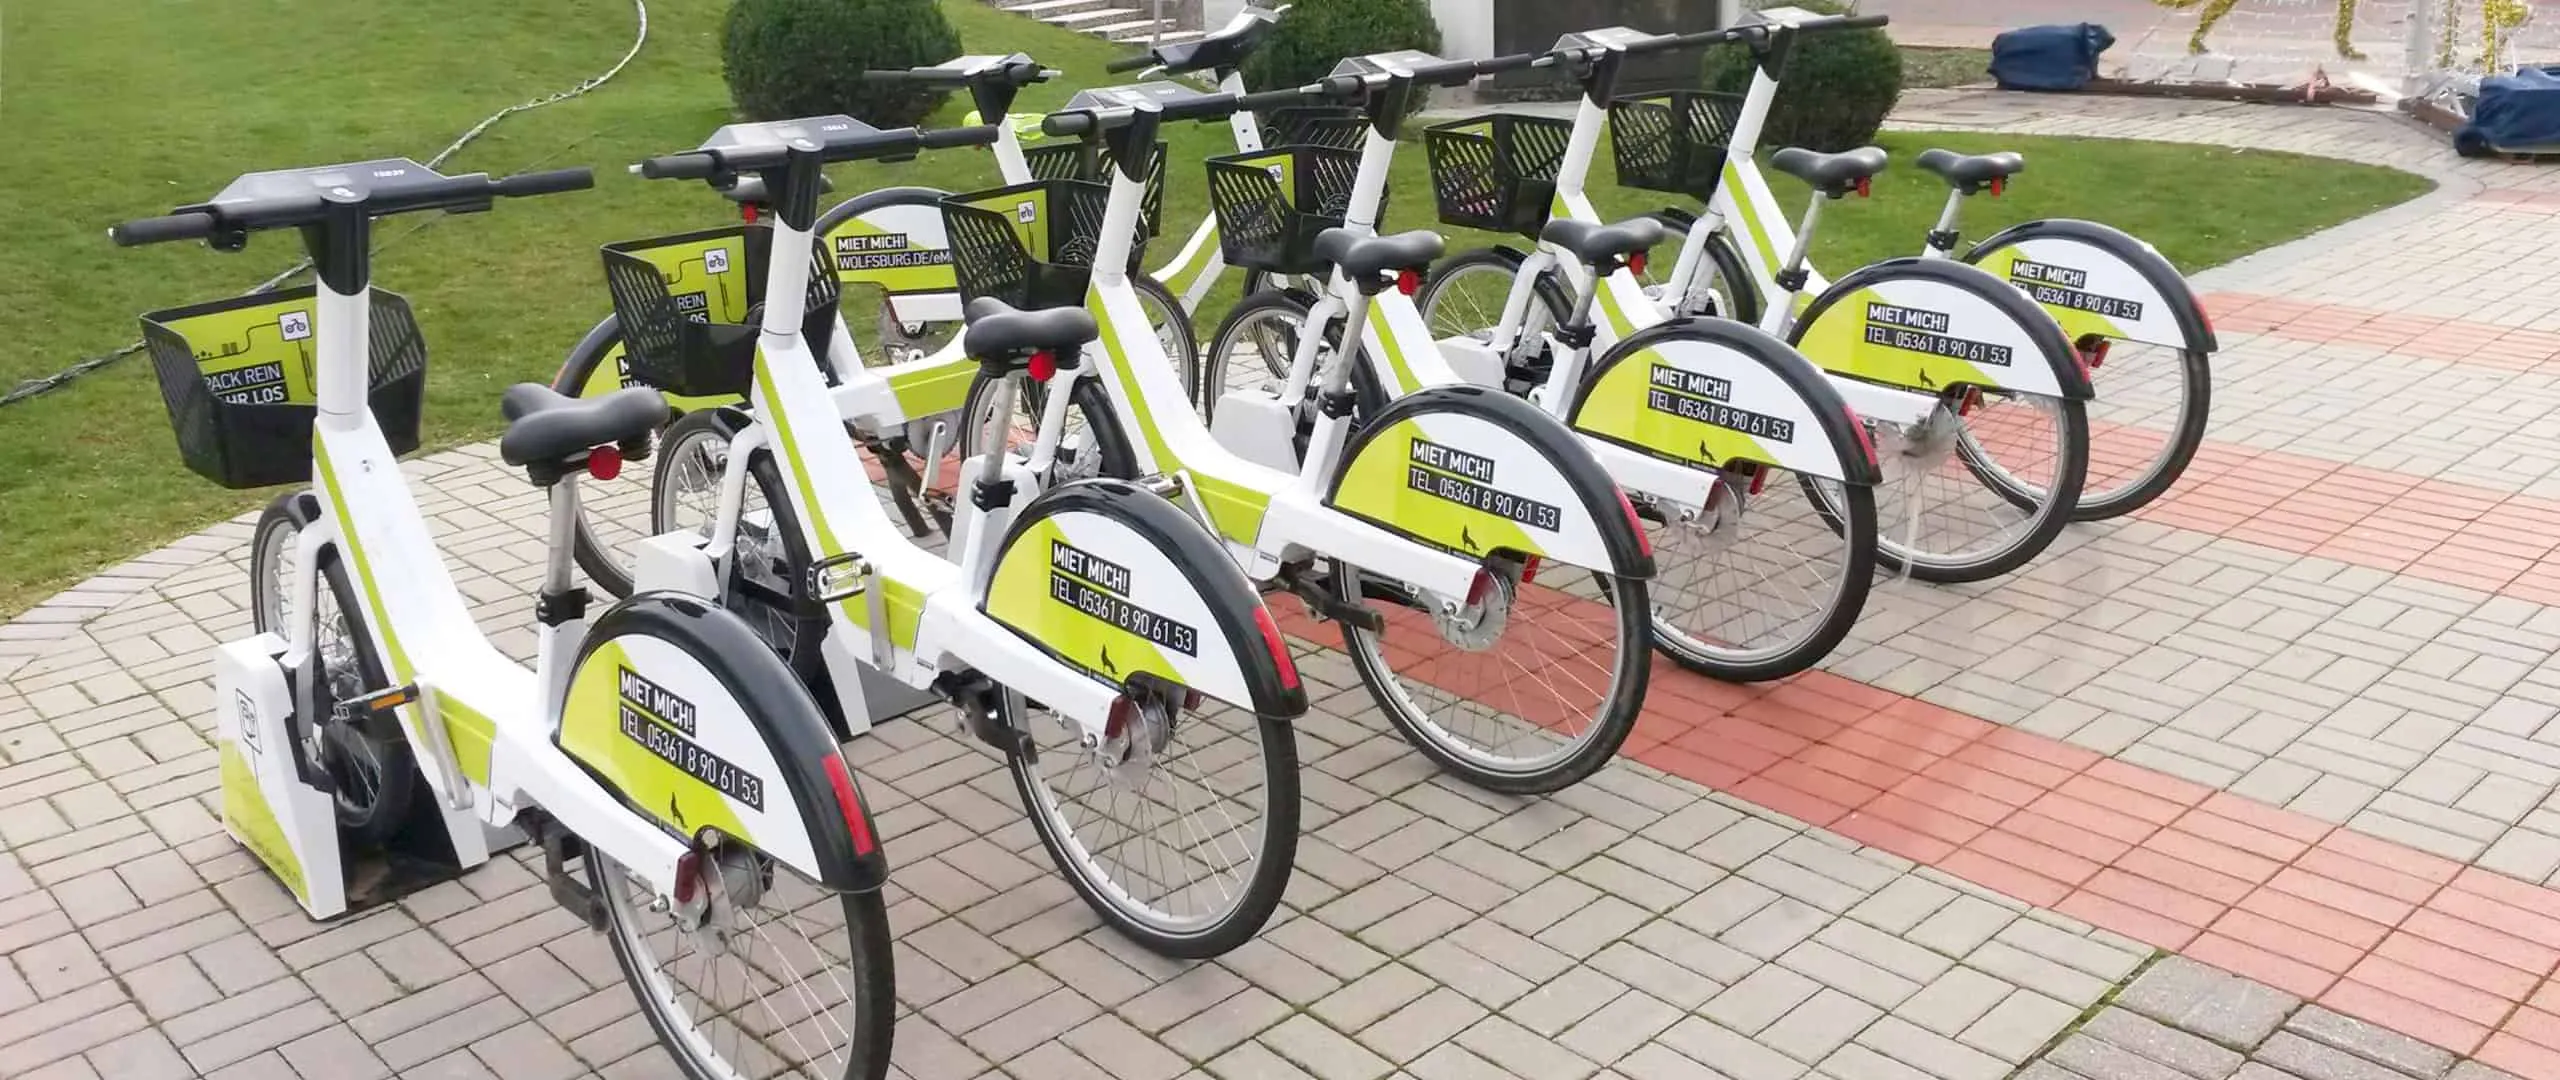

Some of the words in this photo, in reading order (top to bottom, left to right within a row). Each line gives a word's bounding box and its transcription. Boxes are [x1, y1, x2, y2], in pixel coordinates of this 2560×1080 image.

[838, 237, 867, 251] MIET
[871, 235, 905, 249] MICH!
[839, 250, 953, 269] WOLFSBURG.DE/eM
[2014, 261, 2045, 279] MIET
[2046, 267, 2084, 288] MICH!
[677, 293, 705, 309] REIN
[1869, 304, 1902, 324] MIET
[1905, 311, 1946, 331] MICH!
[2036, 286, 2071, 306] 05361
[2074, 294, 2082, 308] 8
[2086, 296, 2101, 312] 90
[2103, 298, 2118, 315] 61
[2121, 303, 2138, 318] 53
[1867, 326, 1892, 344] TEL.
[1895, 331, 1933, 352] 05361
[1938, 338, 1946, 353] 8
[1950, 340, 1967, 357] 90
[1969, 344, 1985, 360] 61
[1990, 347, 2008, 363] 53
[244, 363, 281, 384] REIN
[1652, 365, 1685, 388] MIET
[1688, 374, 1728, 399] MICH!
[252, 385, 284, 404] LOS
[1650, 389, 1675, 412] TEL.
[1678, 398, 1714, 422] 05361
[1720, 408, 1729, 425] 8
[1732, 411, 1748, 430] 90
[1751, 416, 1766, 435] 61
[1772, 420, 1790, 440] 53
[1412, 440, 1446, 465] MIET
[1450, 453, 1491, 480] MICH!
[1411, 468, 1436, 492] TEL.
[1439, 477, 1477, 508] 05361
[1482, 490, 1491, 510] 8
[1495, 494, 1512, 516] 90
[1515, 501, 1531, 521] 61
[1537, 507, 1555, 528] 53
[1053, 543, 1086, 574] MIET
[1088, 556, 1127, 593] MICH!
[1052, 575, 1076, 604] TEL.
[1079, 587, 1115, 622] 05361
[1120, 605, 1129, 627] 8
[1132, 610, 1149, 636] 90
[1153, 618, 1169, 643] 61
[1175, 626, 1193, 651] 53
[620, 672, 652, 708] MIET
[654, 688, 694, 732] MICH!
[621, 706, 646, 742] TEL.
[647, 723, 683, 765] 05361
[687, 747, 697, 772] 8
[700, 754, 716, 784] 90
[720, 765, 735, 793] 61
[741, 775, 759, 806] 53
